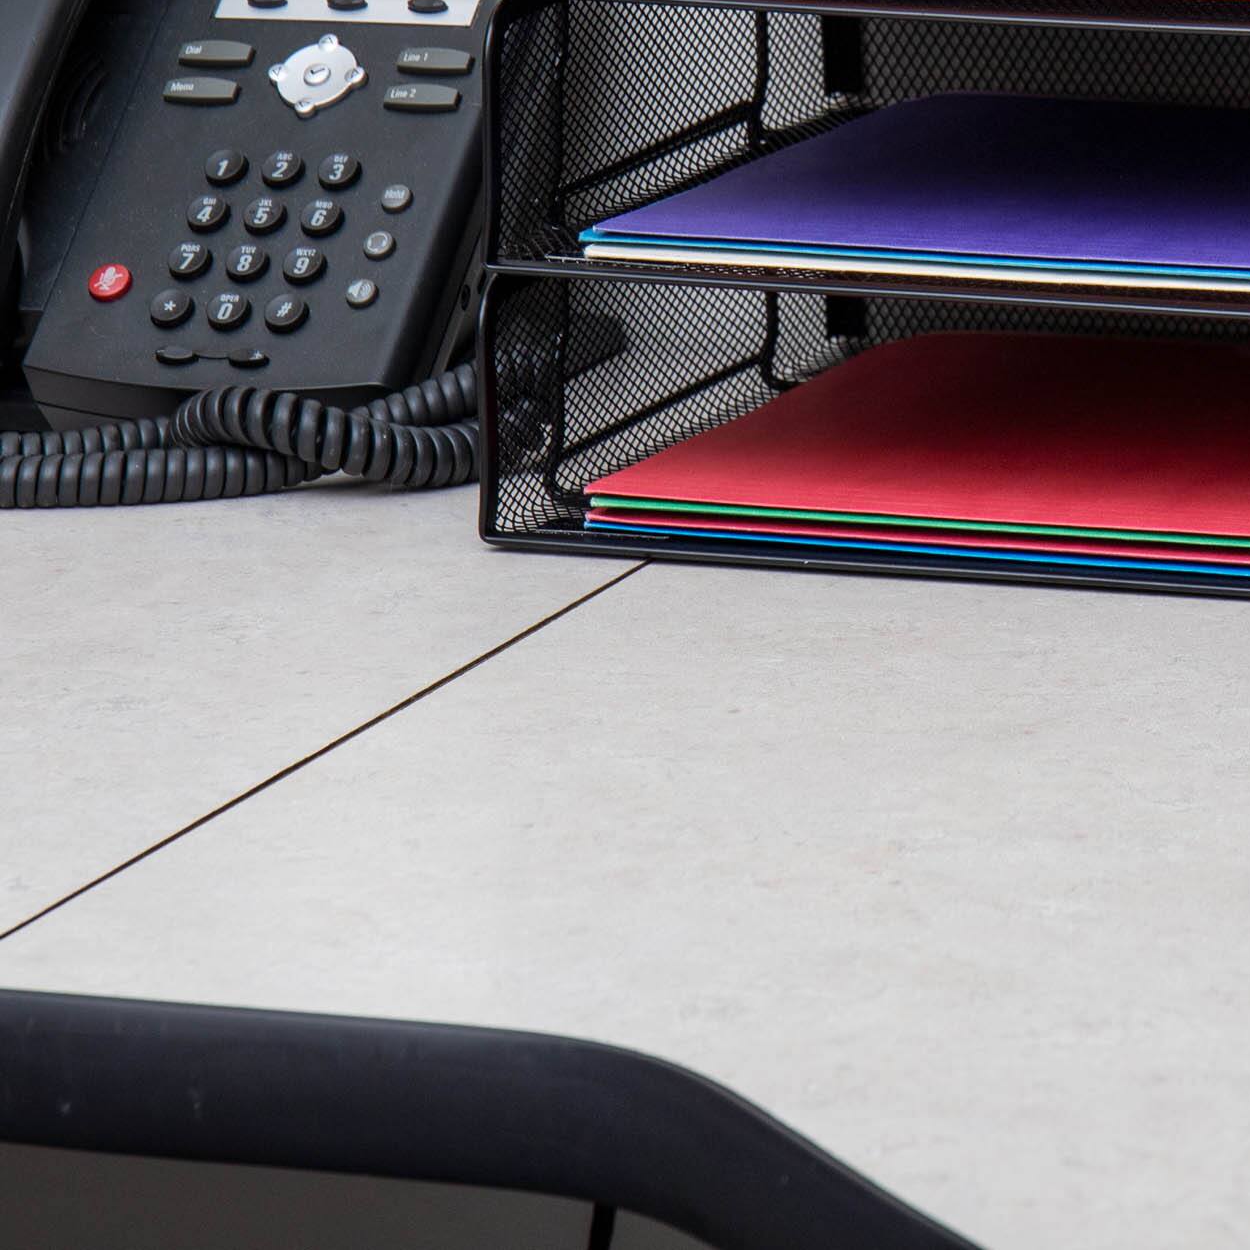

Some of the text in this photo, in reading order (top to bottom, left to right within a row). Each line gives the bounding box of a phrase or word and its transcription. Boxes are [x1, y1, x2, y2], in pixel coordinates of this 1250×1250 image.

[217, 159, 229, 177] 1
[271, 161, 288, 178] 2
[328, 164, 345, 181] 3
[196, 206, 213, 223] 4
[253, 207, 270, 224] 5
[311, 209, 327, 226] 6
[179, 252, 194, 270] 7
[236, 254, 252, 272] 8
[294, 257, 310, 275] 9
[217, 303, 233, 320] 0
